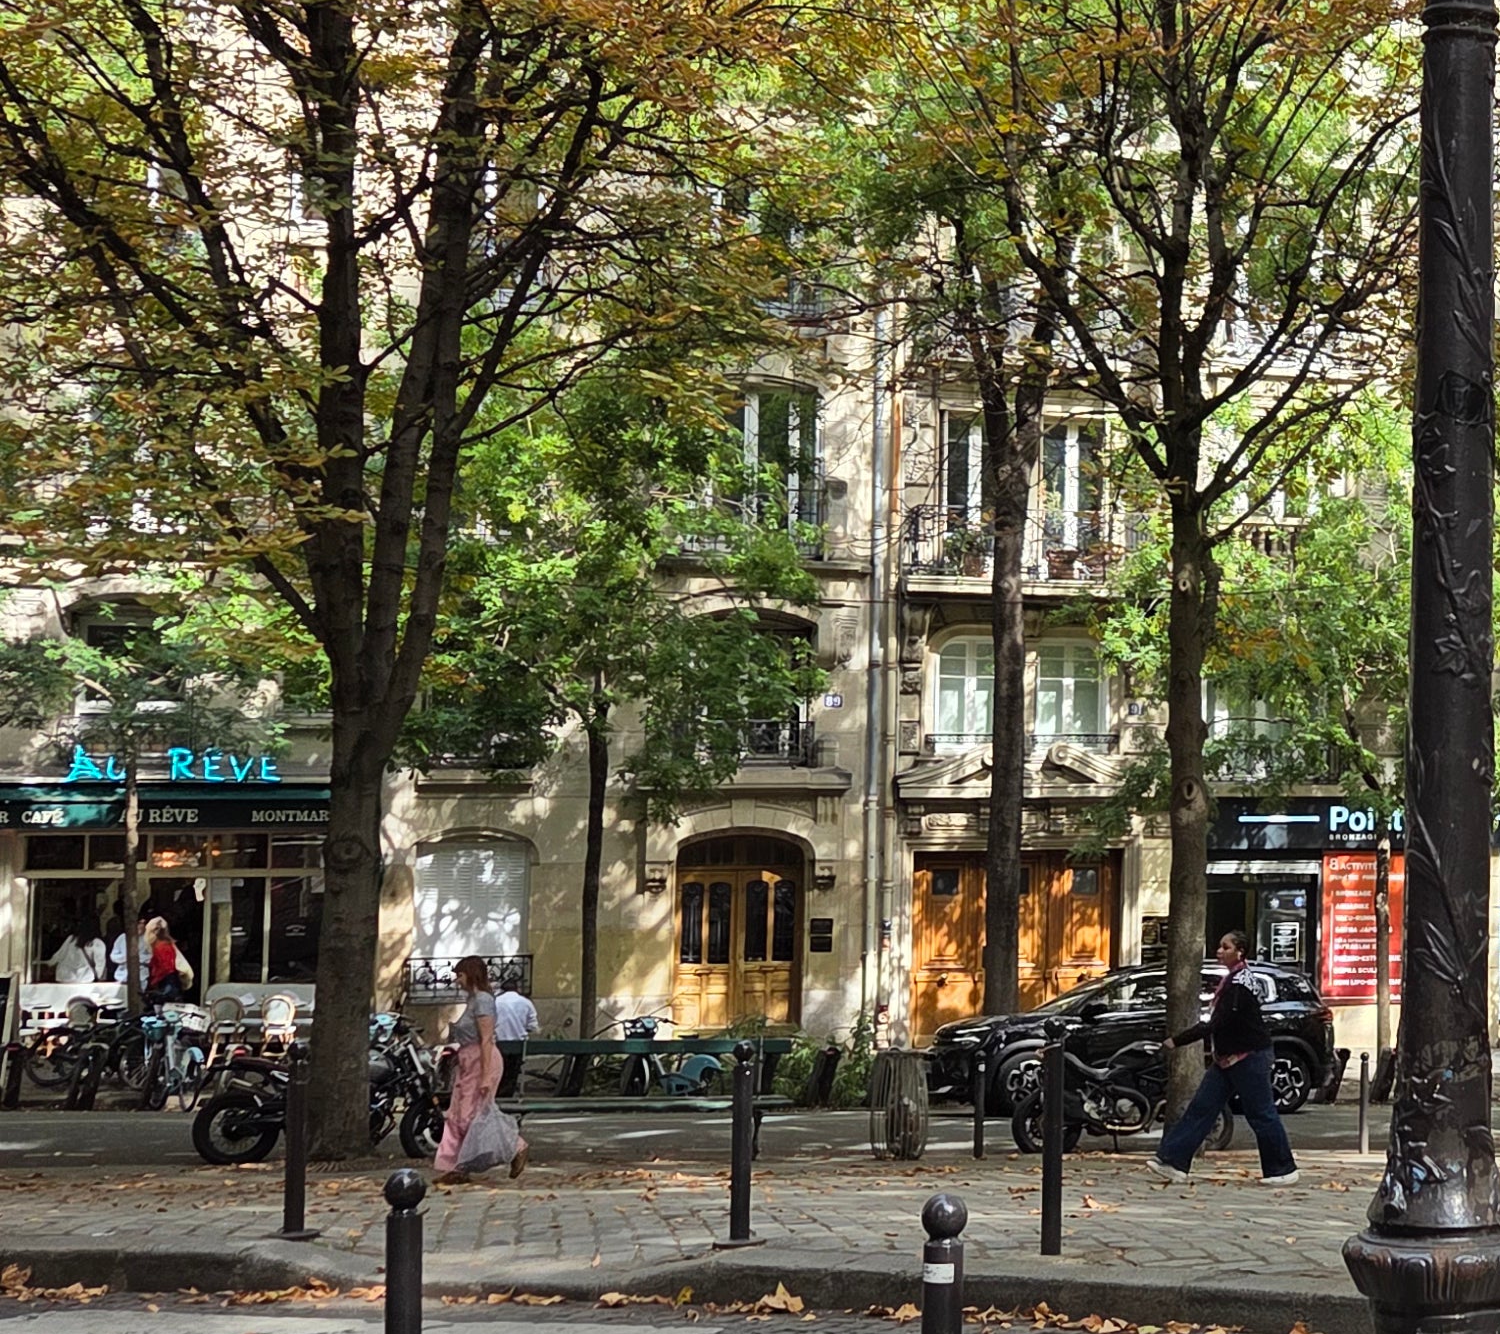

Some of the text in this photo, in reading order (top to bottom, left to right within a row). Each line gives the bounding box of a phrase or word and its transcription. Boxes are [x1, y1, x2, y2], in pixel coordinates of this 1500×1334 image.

[825, 695, 841, 707] 89
[21, 808, 65, 824] CAFÉ
[251, 809, 330, 823] MONTMAR
[1329, 805, 1403, 832] Poit
[1329, 833, 1377, 841] BRONZAG
[1329, 857, 1339, 871] 8
